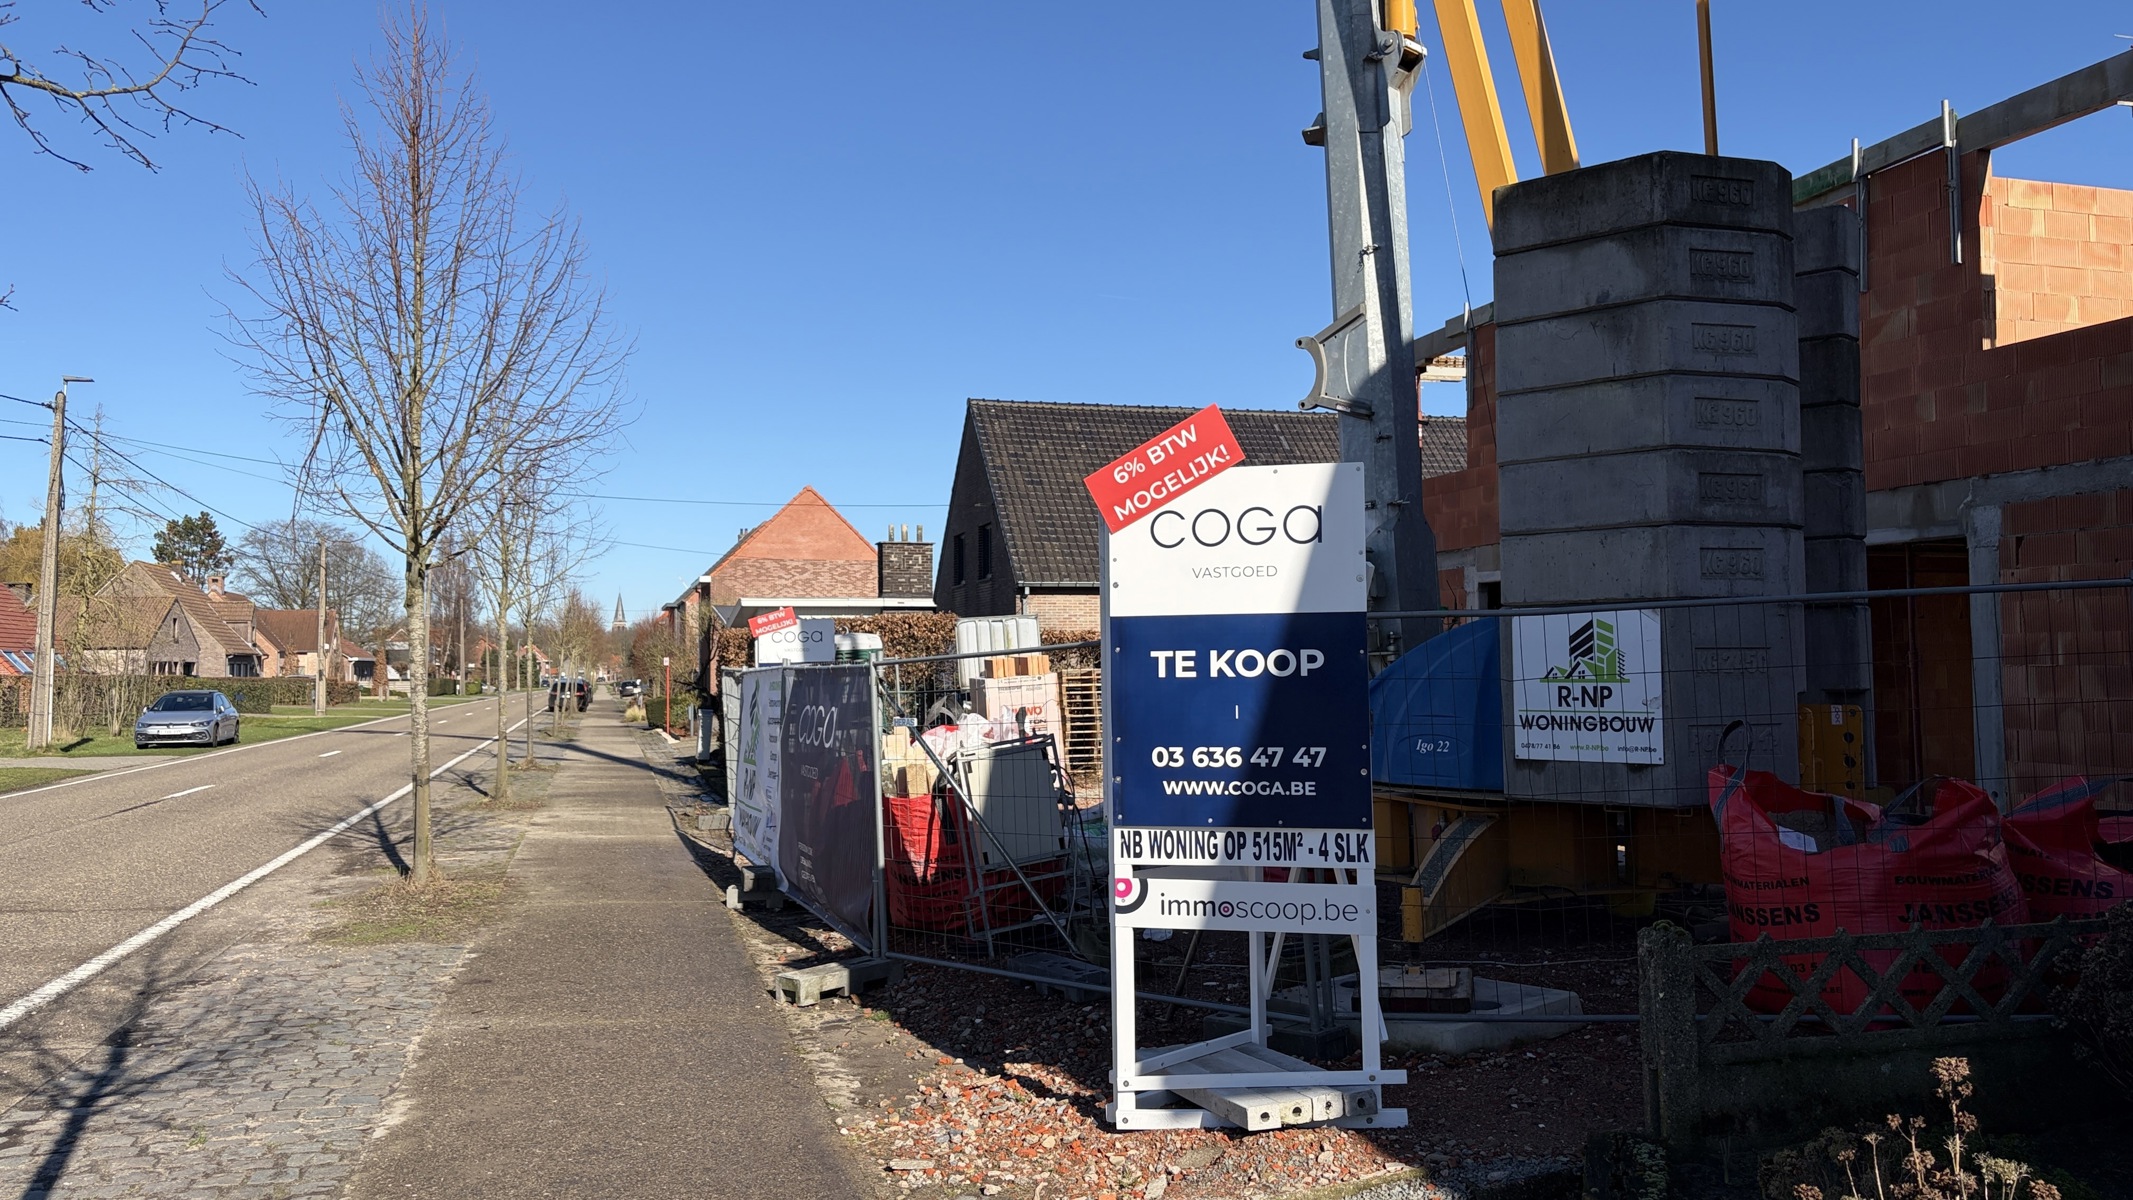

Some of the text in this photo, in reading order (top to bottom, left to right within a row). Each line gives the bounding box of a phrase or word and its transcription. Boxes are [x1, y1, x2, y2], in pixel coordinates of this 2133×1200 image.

[1113, 423, 1198, 485] 6% BTW
[1112, 443, 1232, 522] MOGELIJK!
[1191, 565, 1278, 579] VASTGOED
[769, 611, 786, 622] BTW
[1150, 648, 1325, 678] TE KOOP
[1557, 685, 1613, 708] R-NP
[894, 718, 915, 726] HERAS
[1518, 714, 1655, 734] WONINGBOUW
[1151, 746, 1327, 768] 03 636 47 47
[1416, 739, 1450, 753] Igo 22
[1162, 780, 1317, 796] WWW.COGA.BE
[1120, 830, 1143, 859] NB
[1149, 830, 1219, 860] WONING
[1224, 830, 1247, 861] OP
[1318, 832, 1329, 862] 4
[1335, 832, 1370, 863] SLK
[1160, 892, 1359, 926] immoscoop.be
[1729, 902, 1821, 927] ANSSENS
